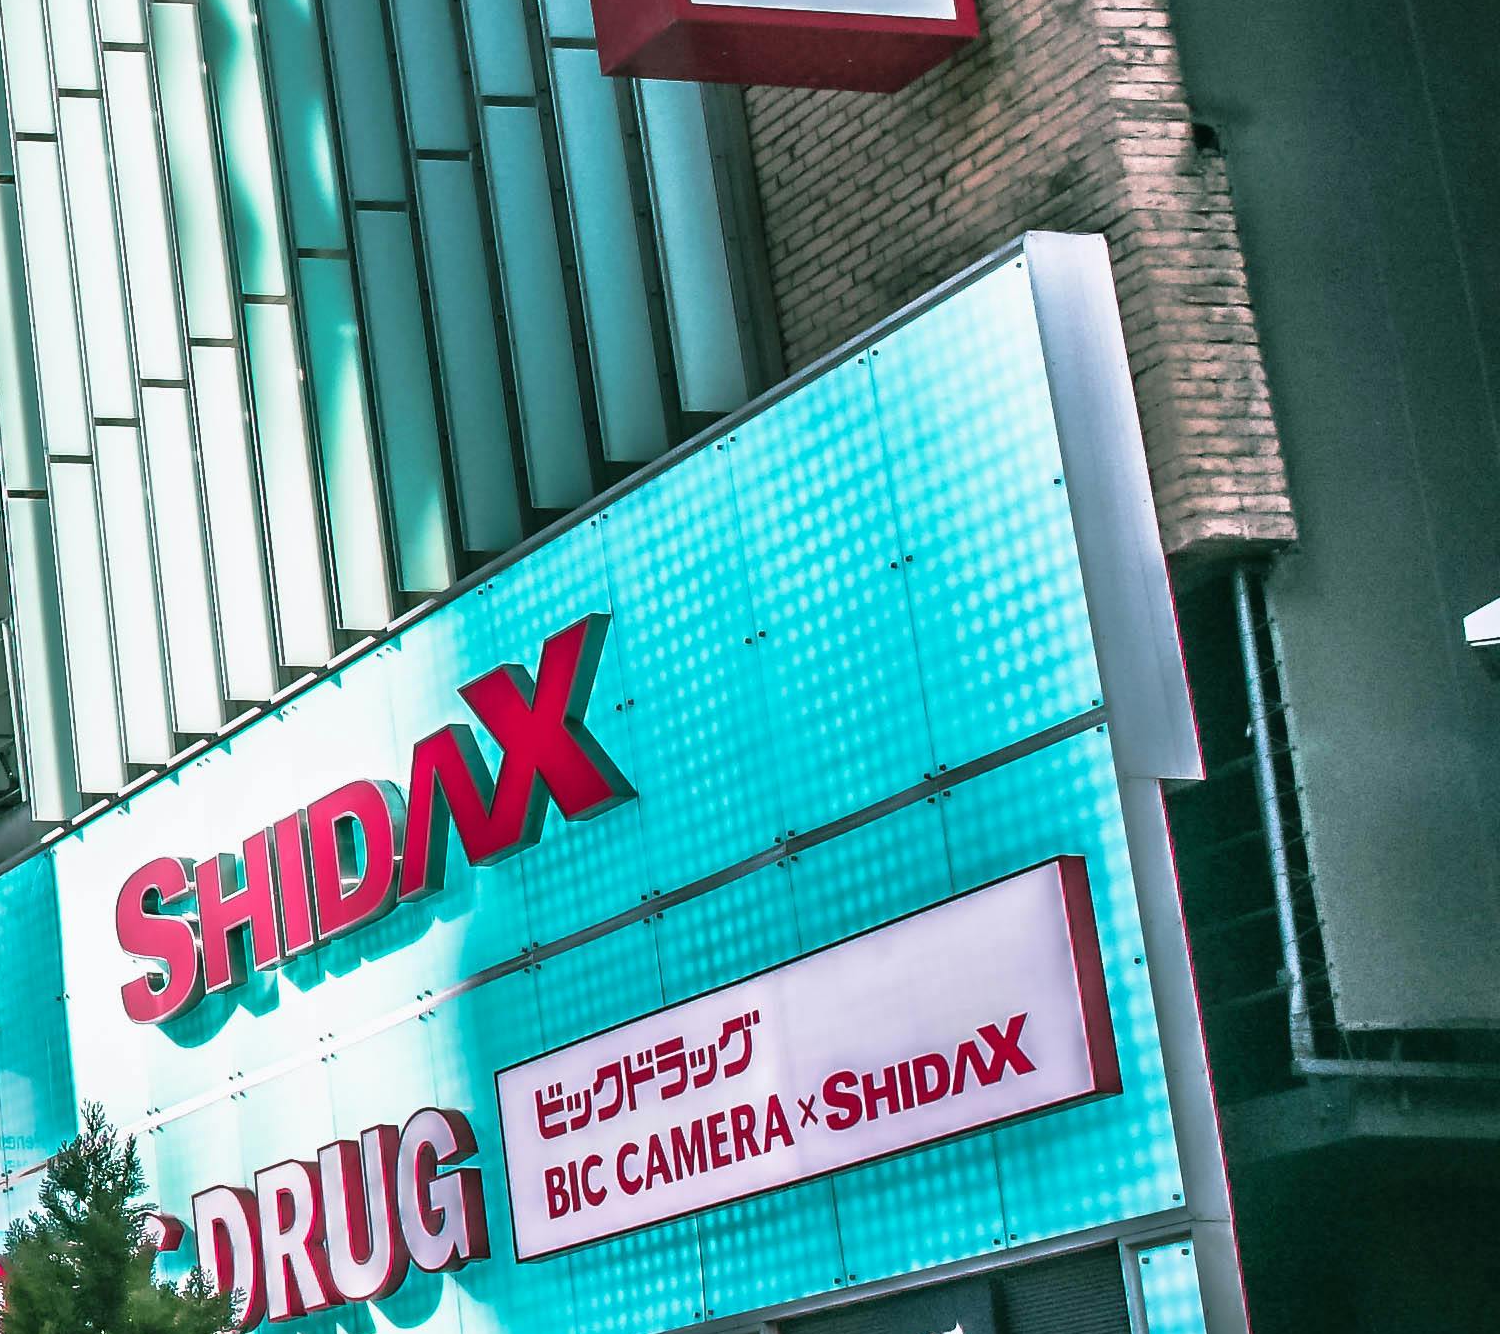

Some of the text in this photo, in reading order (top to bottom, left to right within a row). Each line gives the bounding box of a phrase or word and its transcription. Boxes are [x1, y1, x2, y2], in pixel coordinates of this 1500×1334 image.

[114, 613, 632, 1025] SHIDAX
[534, 1010, 762, 1141] ビックドラッグ
[544, 1154, 608, 1220] BIC
[616, 1093, 795, 1196] CAMERA
[822, 1012, 1037, 1131] SHIDAX
[190, 1106, 489, 1334] DRUG
